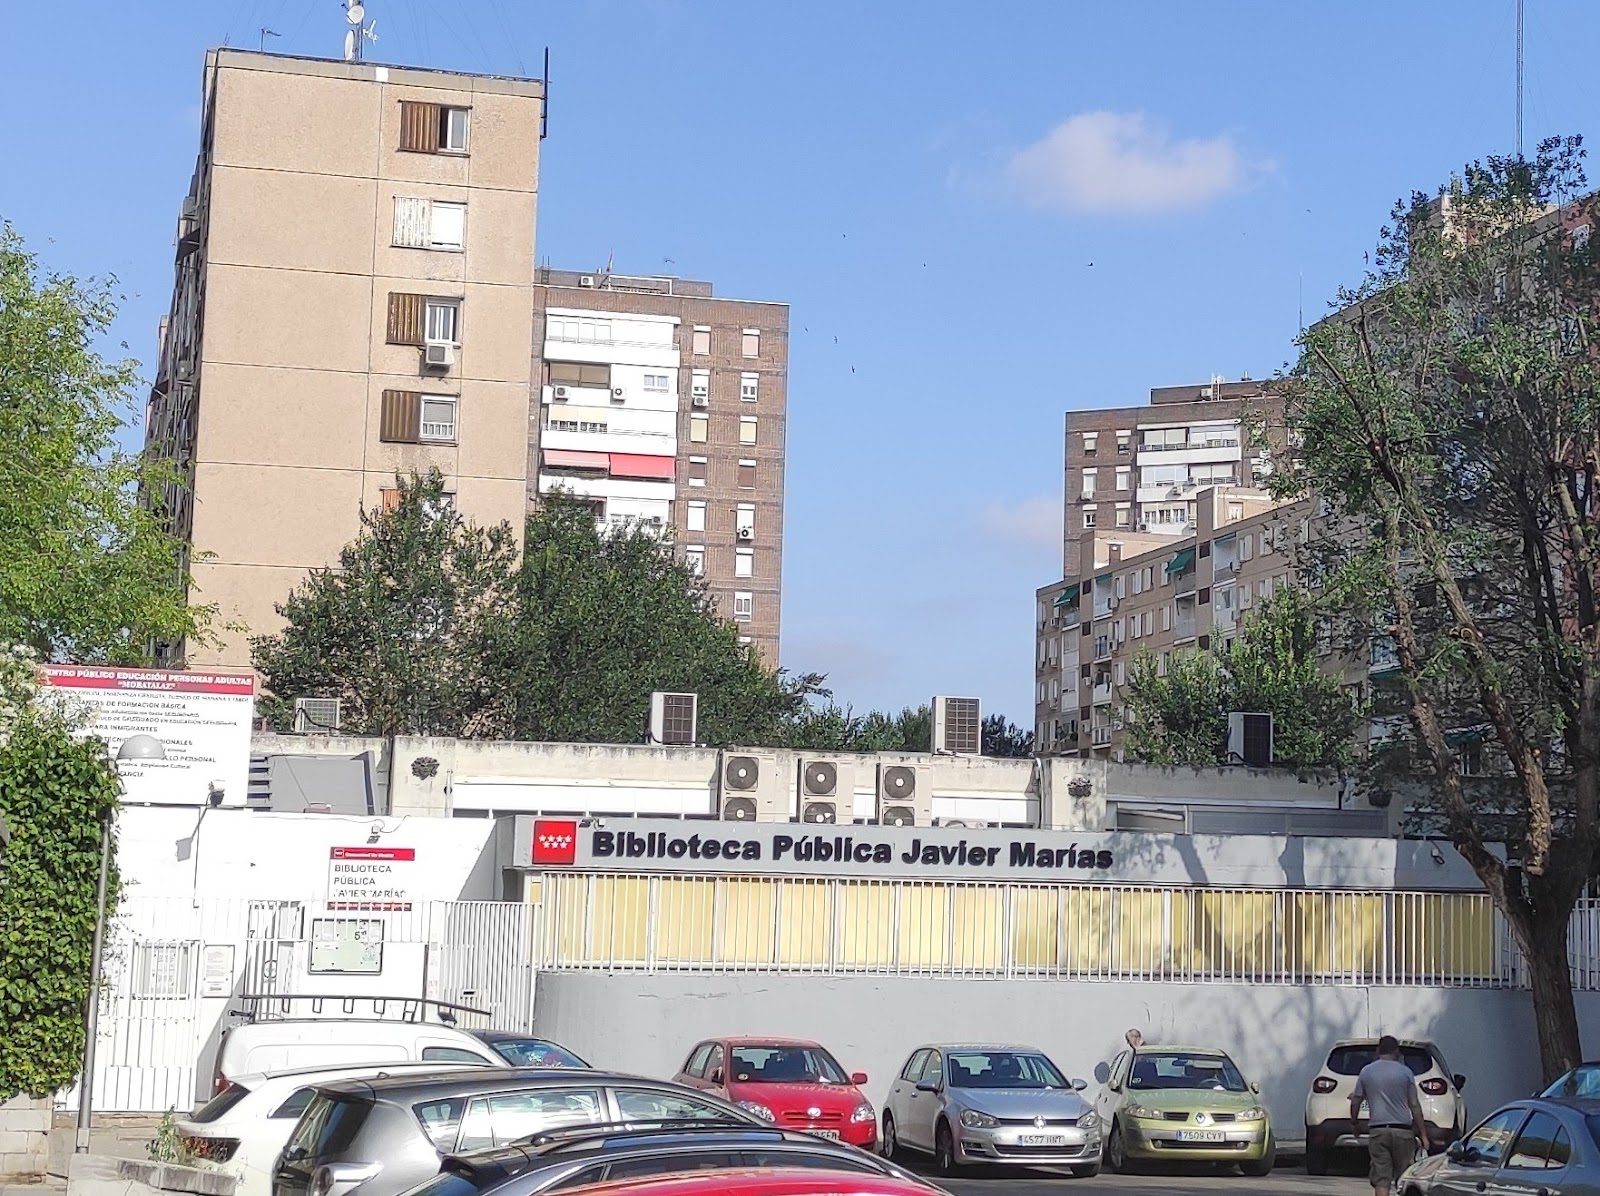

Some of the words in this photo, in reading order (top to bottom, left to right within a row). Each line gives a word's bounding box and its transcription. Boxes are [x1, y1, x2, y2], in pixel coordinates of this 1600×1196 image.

[44, 668, 76, 677] ENTRO
[77, 669, 115, 678] PÚBLICO
[117, 672, 167, 682] EDUCACIÓN
[168, 675, 213, 684] PERSONAS
[214, 677, 252, 686] ADULTAS
[591, 831, 761, 859] Biblioteca
[772, 835, 892, 864] Pública
[901, 839, 1001, 866] Javier
[1009, 842, 1113, 869] Marías
[334, 864, 392, 873] BIBLIOTECA
[333, 876, 376, 885] PÚBLICA
